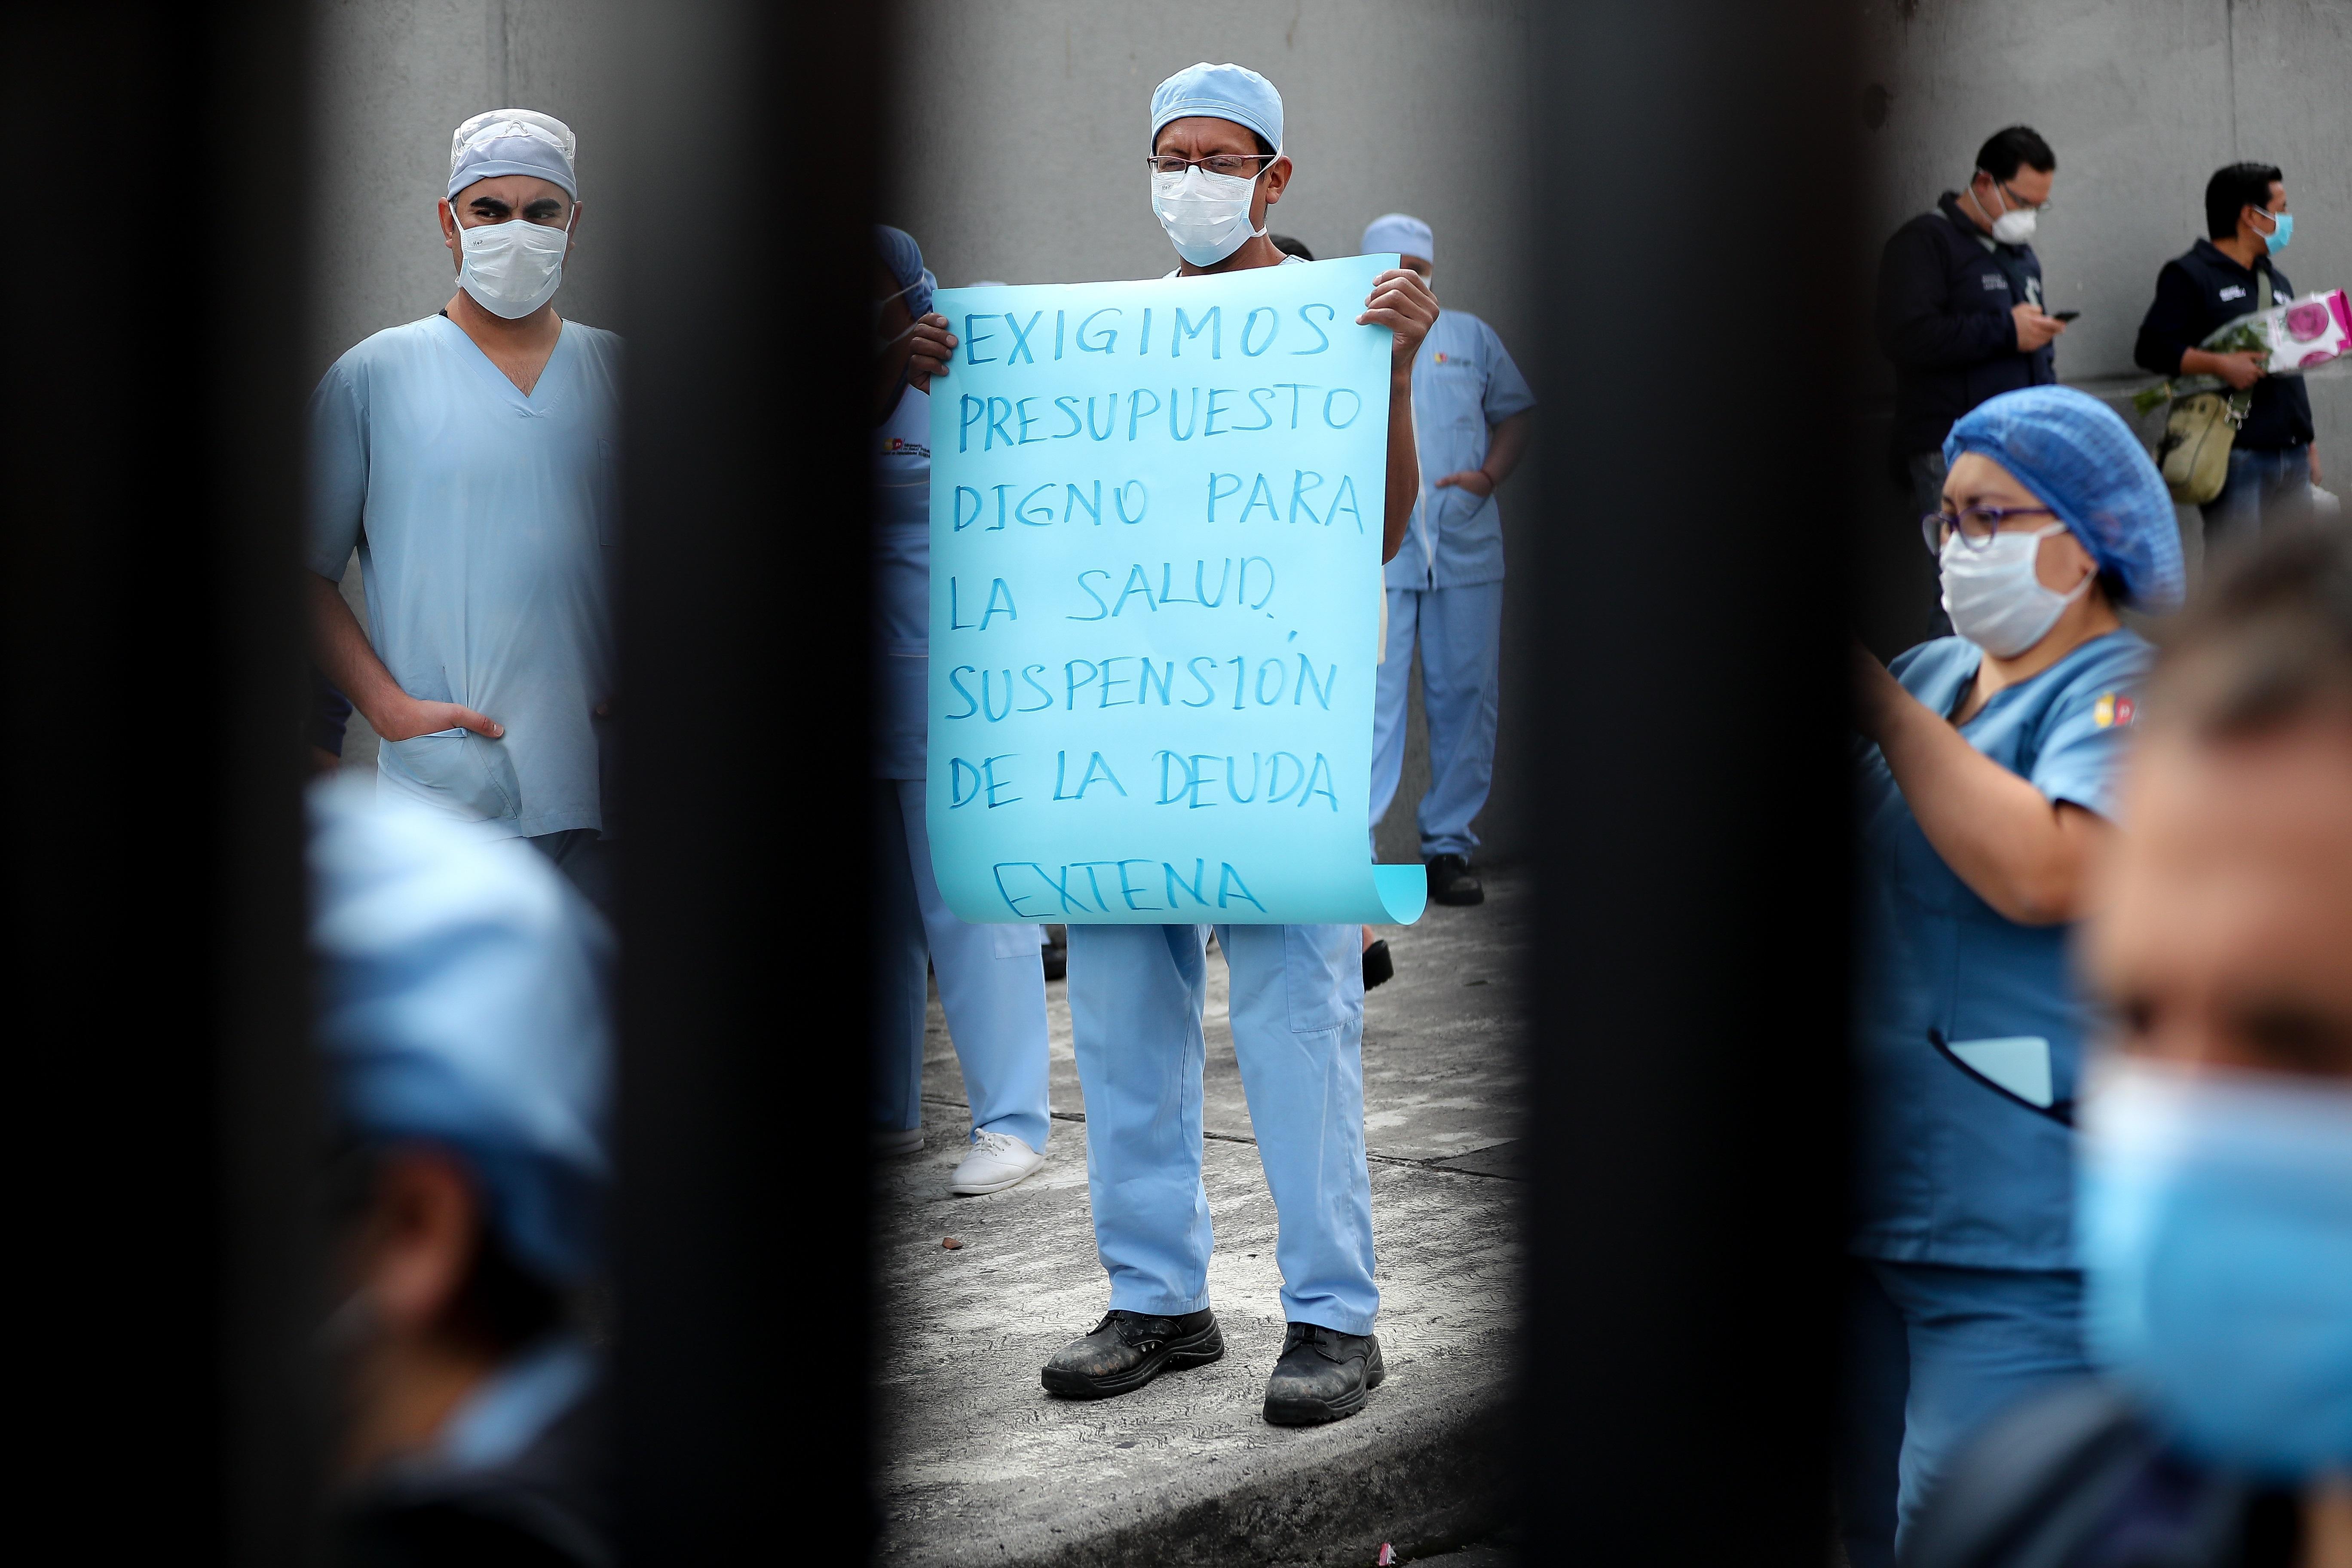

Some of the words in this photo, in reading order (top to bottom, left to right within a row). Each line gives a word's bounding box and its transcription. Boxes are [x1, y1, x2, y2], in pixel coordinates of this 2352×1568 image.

[965, 303, 1335, 366] EXIGIMOS
[959, 383, 1361, 453] PRESUPUESTO
[954, 479, 1147, 532] DIGNO
[1208, 469, 1363, 534] PARA
[951, 576, 1017, 631] LA
[949, 754, 1023, 809] DE
[1053, 750, 1127, 801] LA
[1154, 750, 1338, 812] DEUDA
[992, 858, 1267, 917] EXTENA
